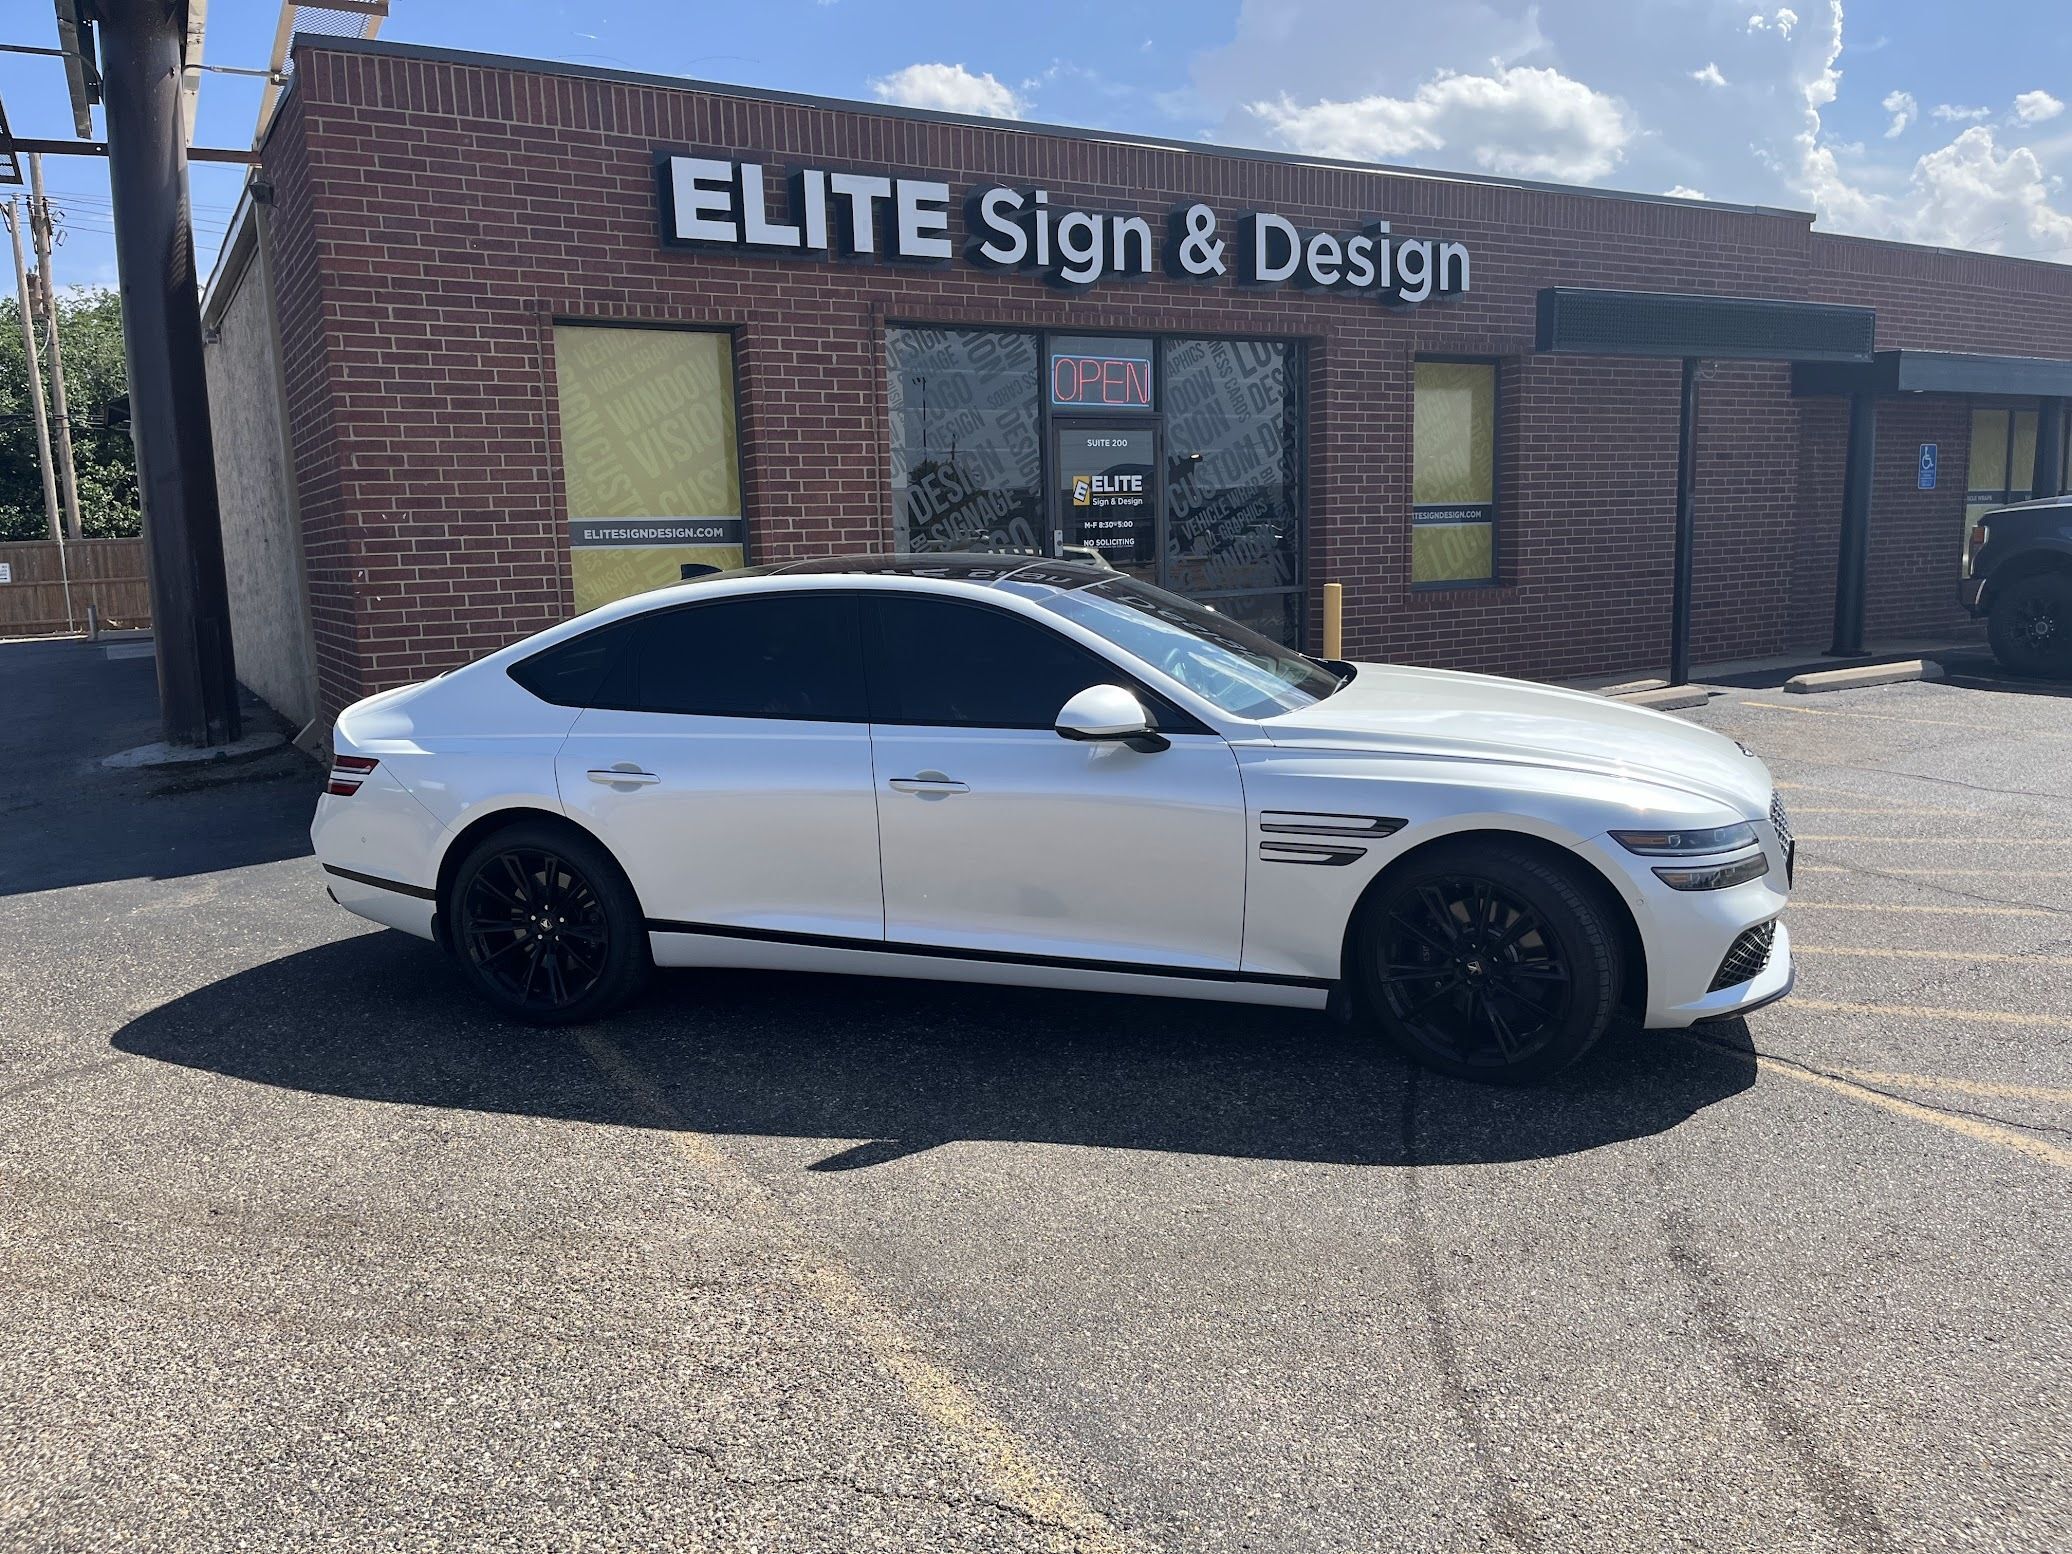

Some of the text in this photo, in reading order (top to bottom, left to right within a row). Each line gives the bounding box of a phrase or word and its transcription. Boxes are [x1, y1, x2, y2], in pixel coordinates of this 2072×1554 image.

[671, 156, 1471, 302] ELITE Sign & Design
[1054, 358, 1149, 404] OPEN
[928, 405, 985, 453] DESIGN
[1087, 439, 1128, 447] SUITE 200
[906, 438, 1006, 525] DESIGN
[1091, 475, 1143, 492] ELITE
[1168, 434, 1260, 518] CUSTOM
[931, 486, 1021, 552] SIGNAGE
[1092, 498, 1109, 507] Sign
[1118, 497, 1143, 506] Design
[1182, 492, 1230, 541] VEHICLE
[1218, 497, 1268, 542] GRAPHICS
[584, 527, 723, 540] ELITESIGNDESIGN.COM
[1096, 538, 1135, 546] SOLICITING
